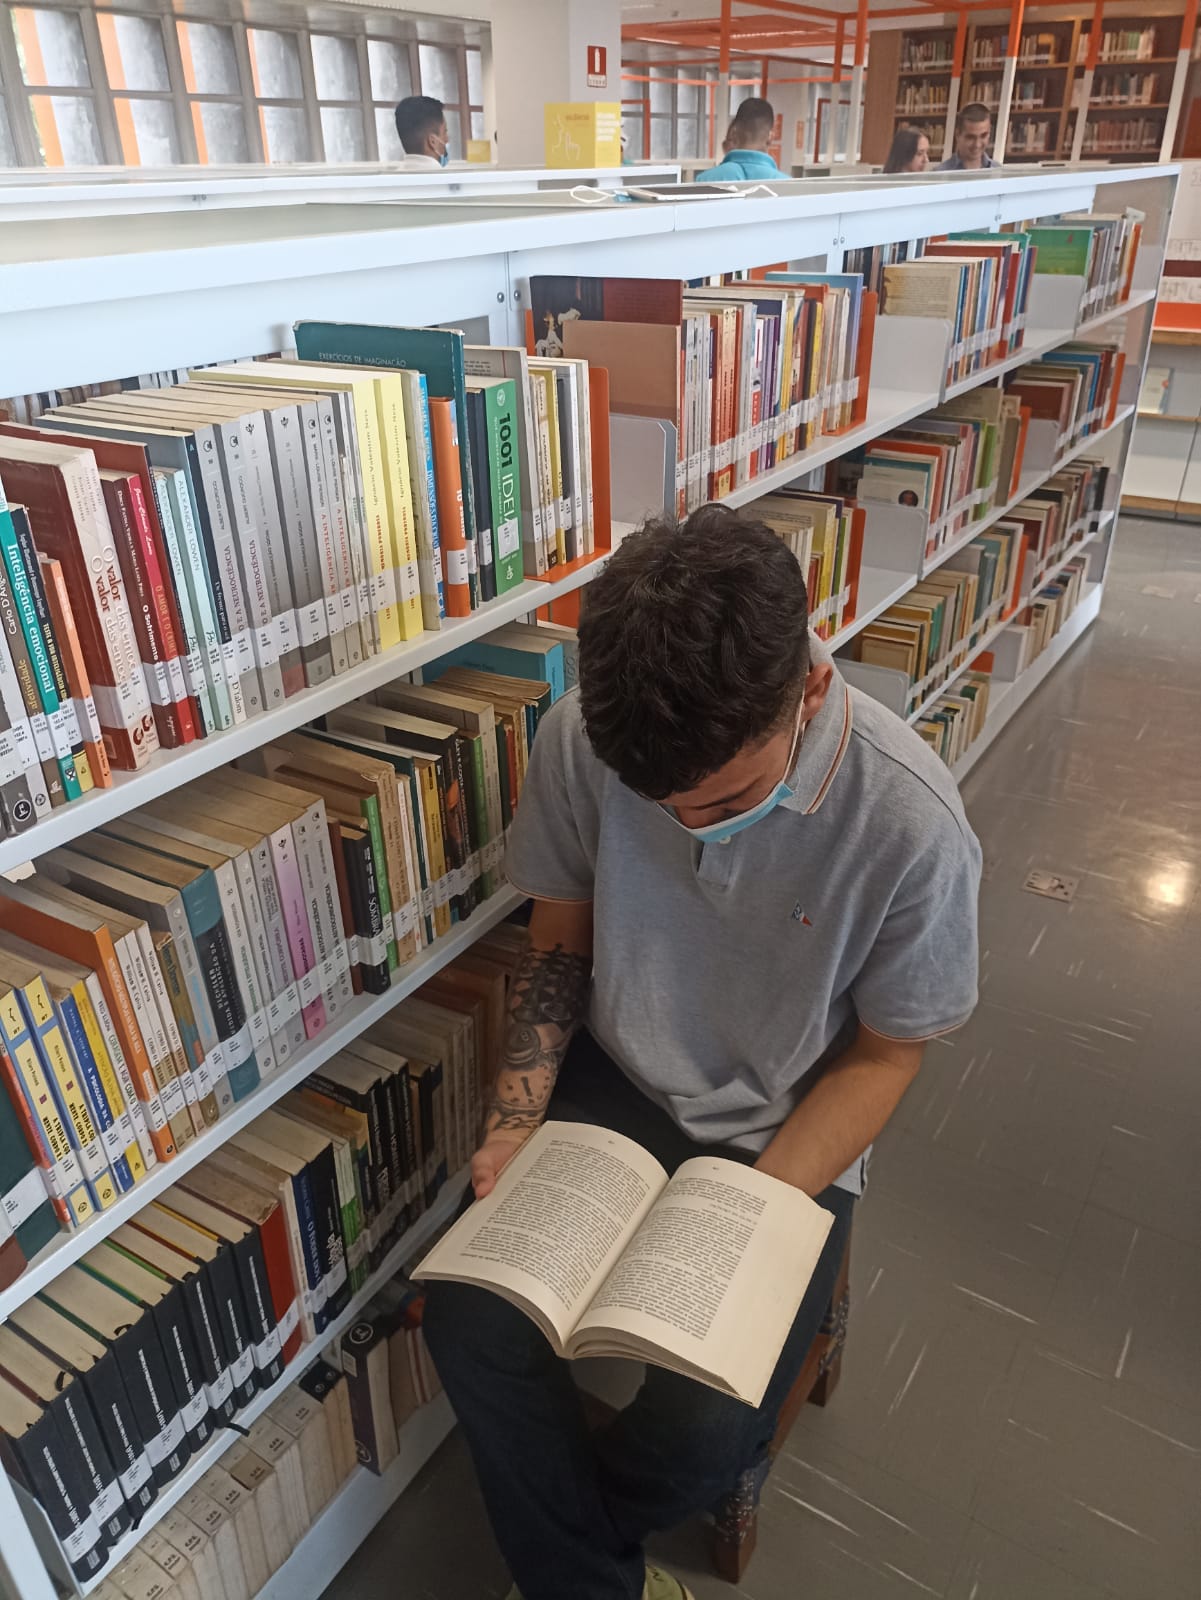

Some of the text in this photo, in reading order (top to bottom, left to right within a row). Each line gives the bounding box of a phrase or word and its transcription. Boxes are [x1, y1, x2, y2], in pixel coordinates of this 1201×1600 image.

[498, 412, 512, 468] 1001
[222, 546, 239, 604] NEUROCIÊNCIA
[247, 539, 265, 600] NEUROCIÊNCIA
[6, 608, 16, 634] Carlo
[7, 544, 35, 624] Inteligência
[30, 628, 52, 692] emocional
[96, 577, 111, 612] valor
[106, 618, 116, 640] das
[106, 566, 121, 600] valor
[116, 607, 126, 630] das
[142, 604, 159, 660] O Sofrimento
[19, 659, 38, 710] afetividade
[89, 1074, 105, 1109] PSICOLOGIA
[53, 1122, 66, 1143] TRIPLA
[80, 1110, 91, 1130] TRIPLA
